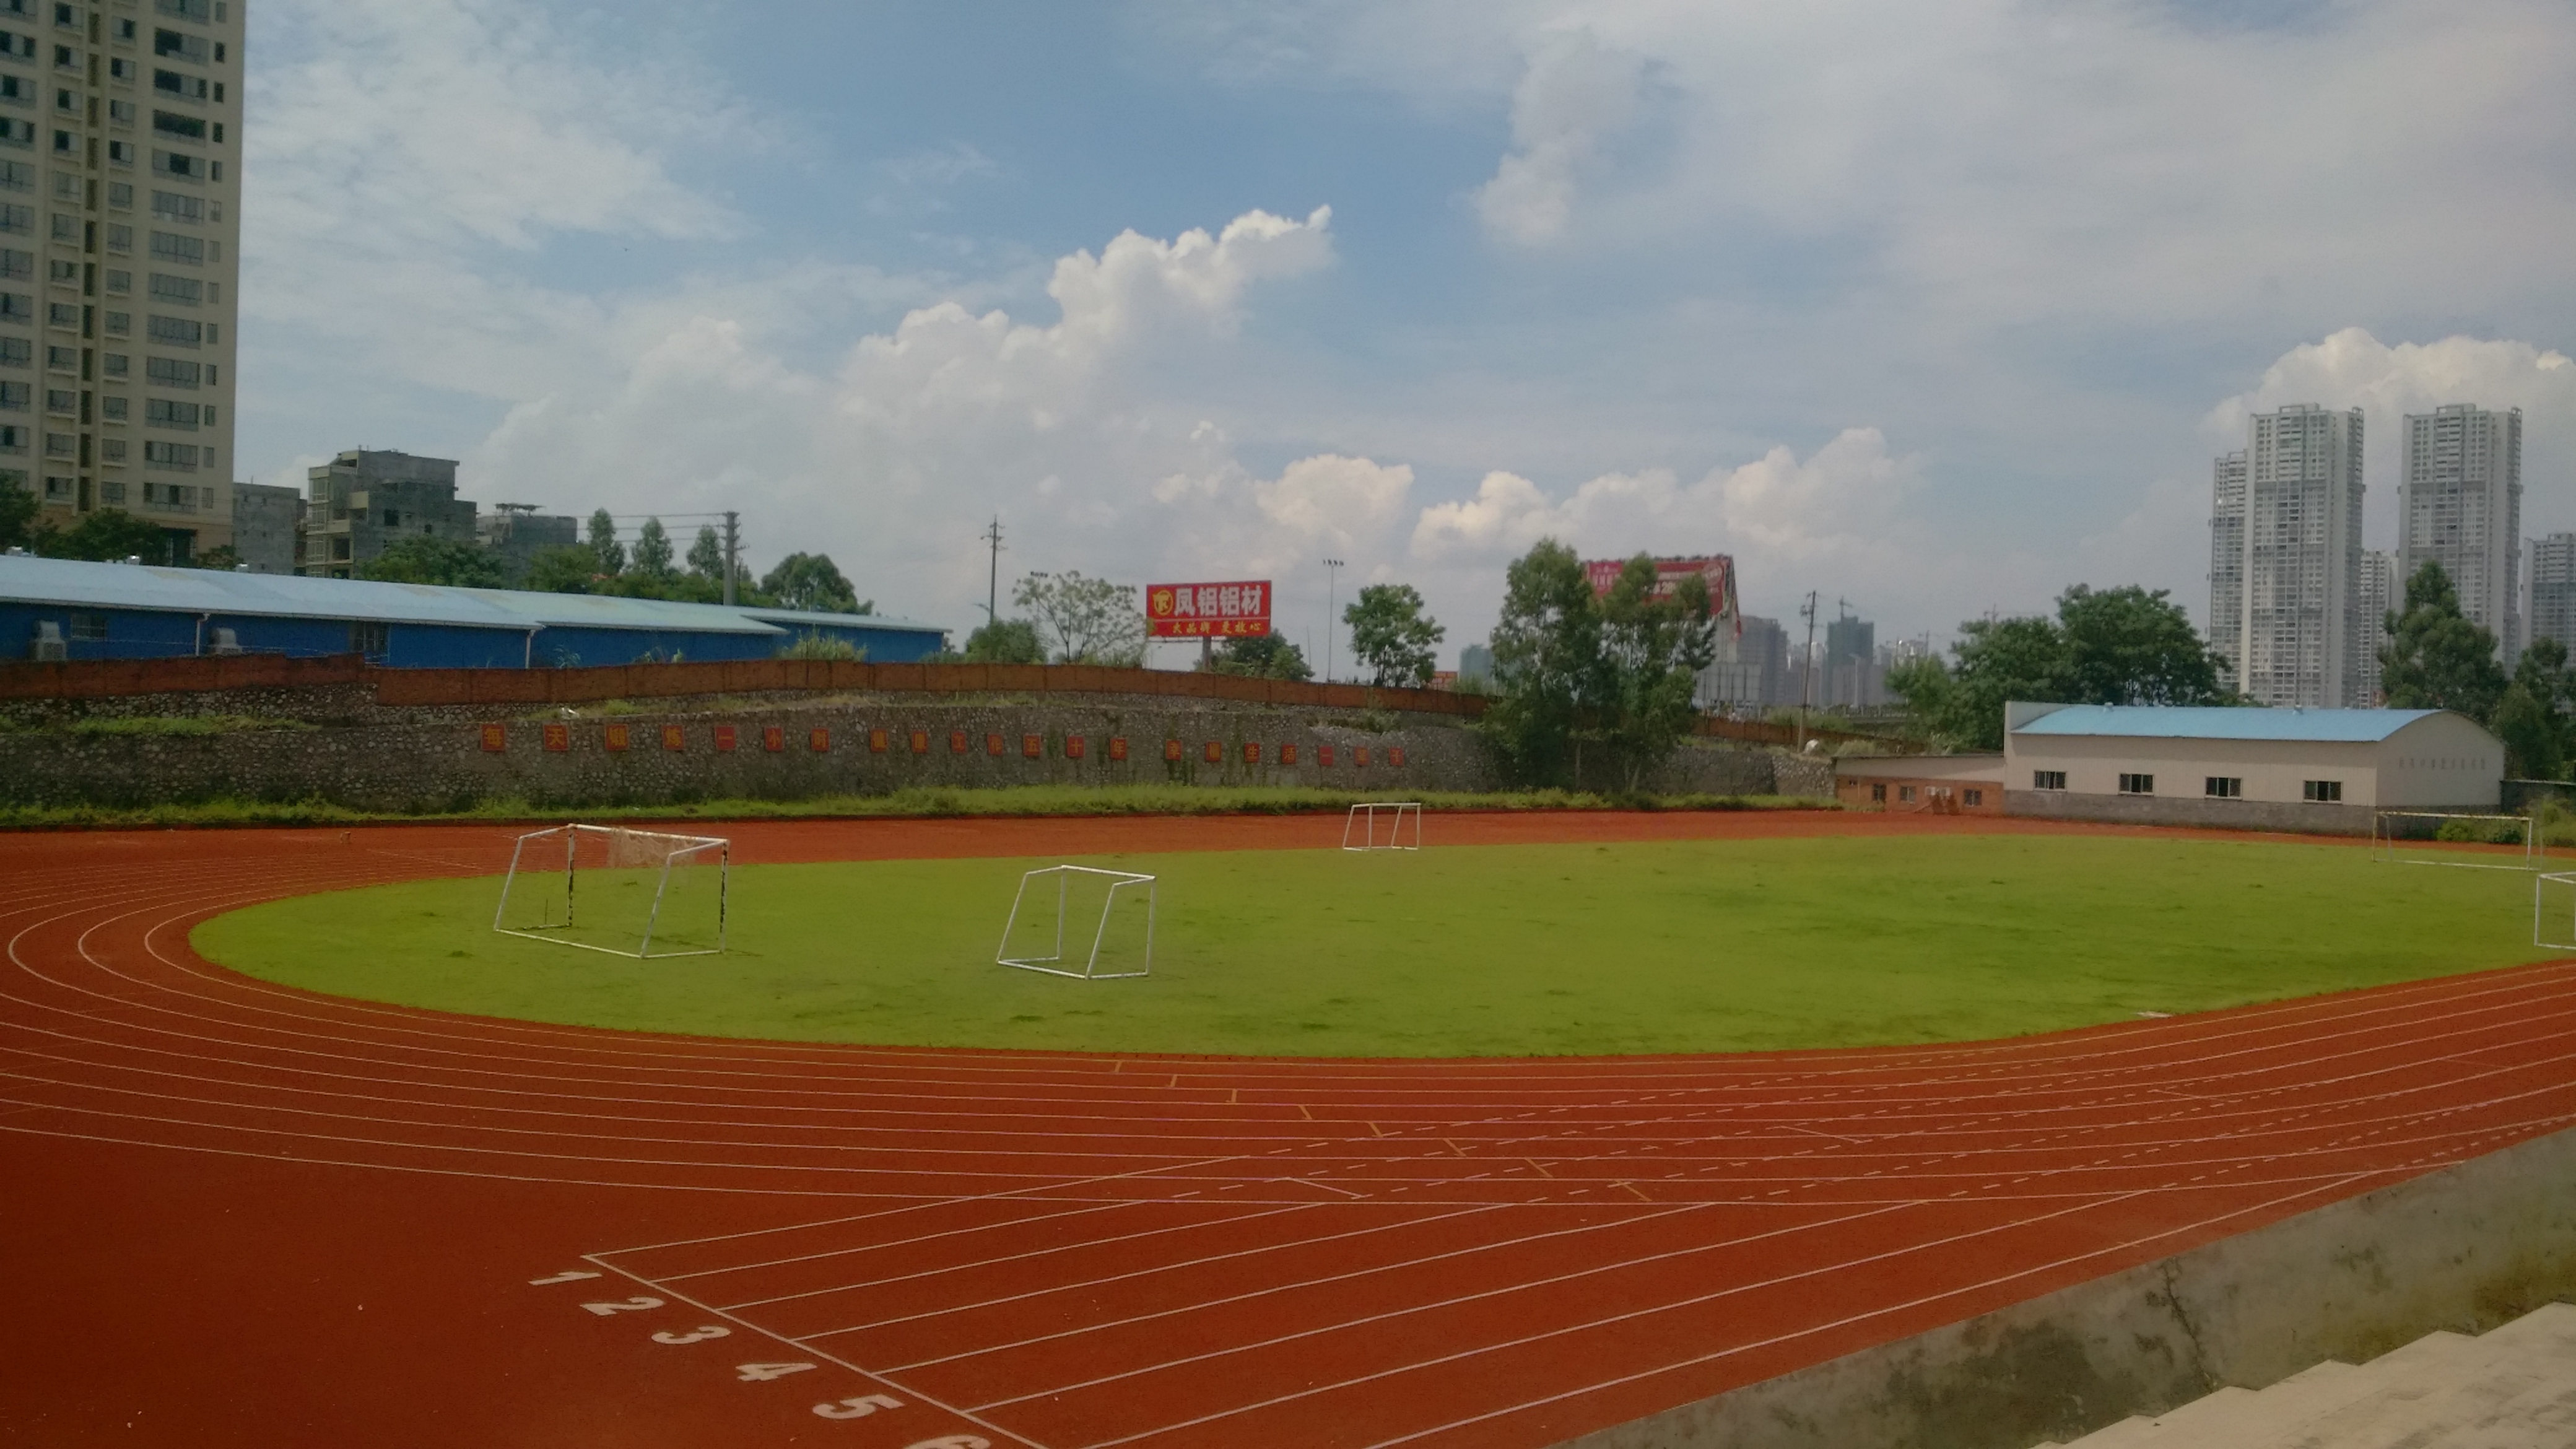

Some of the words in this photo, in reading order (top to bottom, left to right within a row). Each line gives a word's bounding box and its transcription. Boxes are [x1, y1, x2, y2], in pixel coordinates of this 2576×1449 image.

[1175, 585, 1262, 616] 凤铝铝材
[484, 727, 827, 749] 每天锻炼一小时
[528, 1271, 603, 1286] 1
[579, 1297, 665, 1316] 2
[651, 1325, 731, 1344] 3
[735, 1362, 818, 1381] 4
[812, 1394, 905, 1419] 5
